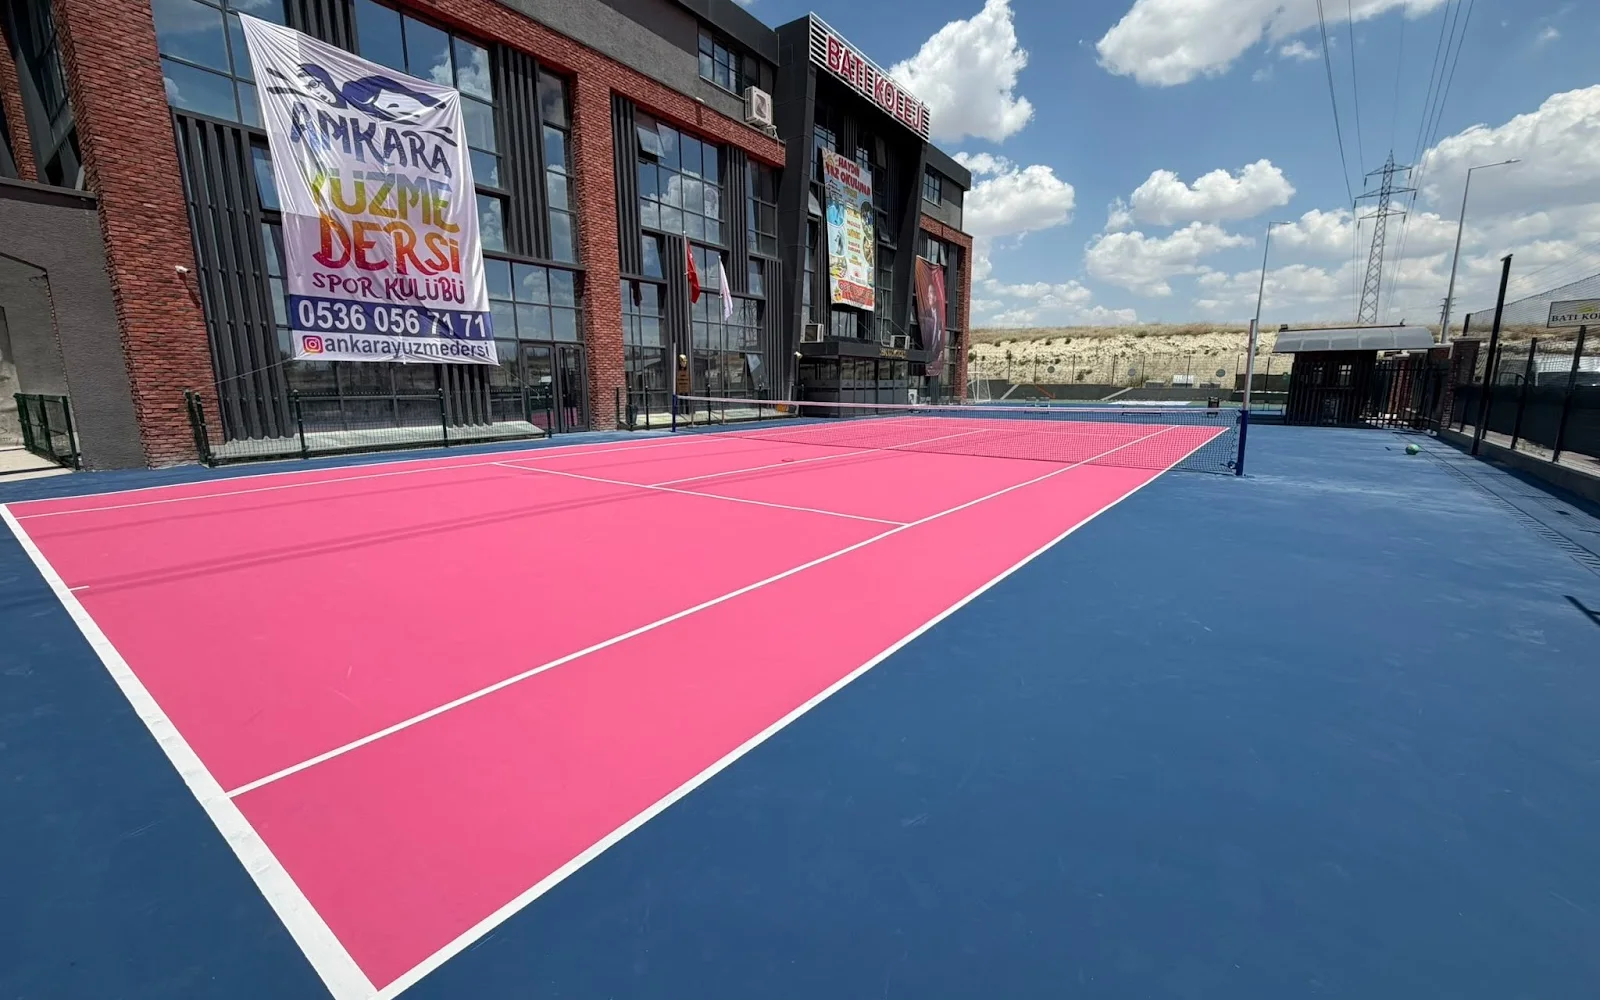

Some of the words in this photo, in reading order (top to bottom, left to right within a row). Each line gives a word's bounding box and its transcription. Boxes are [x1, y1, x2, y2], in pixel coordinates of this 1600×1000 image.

[826, 33, 869, 93] BATI
[290, 101, 453, 178] ANKARA
[312, 211, 461, 276] DERSİ
[312, 272, 382, 299] SPOR
[384, 276, 466, 305] KULÜBÜ
[299, 300, 366, 331] 0536
[374, 306, 420, 334] 056
[427, 311, 455, 336] 71
[460, 314, 486, 338] 71
[1582, 312, 1600, 320] KO
[324, 334, 490, 359] ankarayuzmedersi
